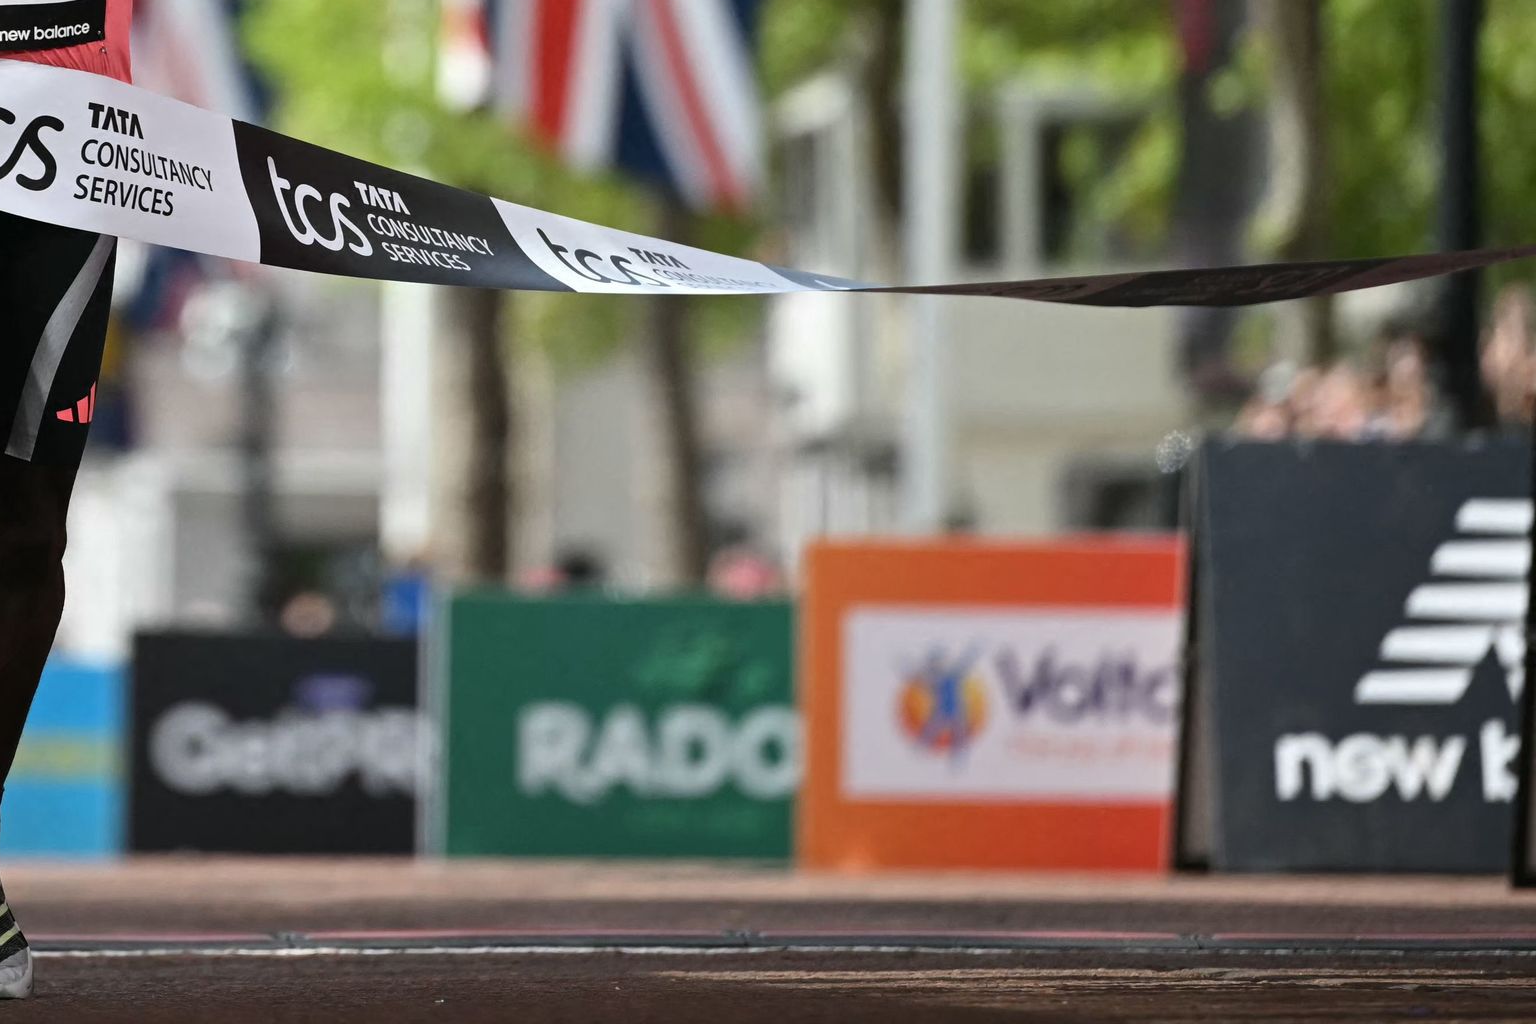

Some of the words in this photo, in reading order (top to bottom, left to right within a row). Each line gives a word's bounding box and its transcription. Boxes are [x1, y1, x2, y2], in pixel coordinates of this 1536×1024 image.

[33, 22, 91, 41] balance
[87, 101, 144, 140] TATA
[80, 138, 214, 192] CONSULTANCY
[73, 173, 174, 217] SERVICES
[266, 155, 374, 257] tcs
[353, 180, 411, 216] TATA
[367, 213, 495, 256] CONSULTANCY
[381, 241, 472, 272] SERVICES
[536, 227, 672, 287] tcs
[627, 246, 691, 270] TATA
[517, 700, 805, 801] RADO
[1275, 732, 1465, 803] new
